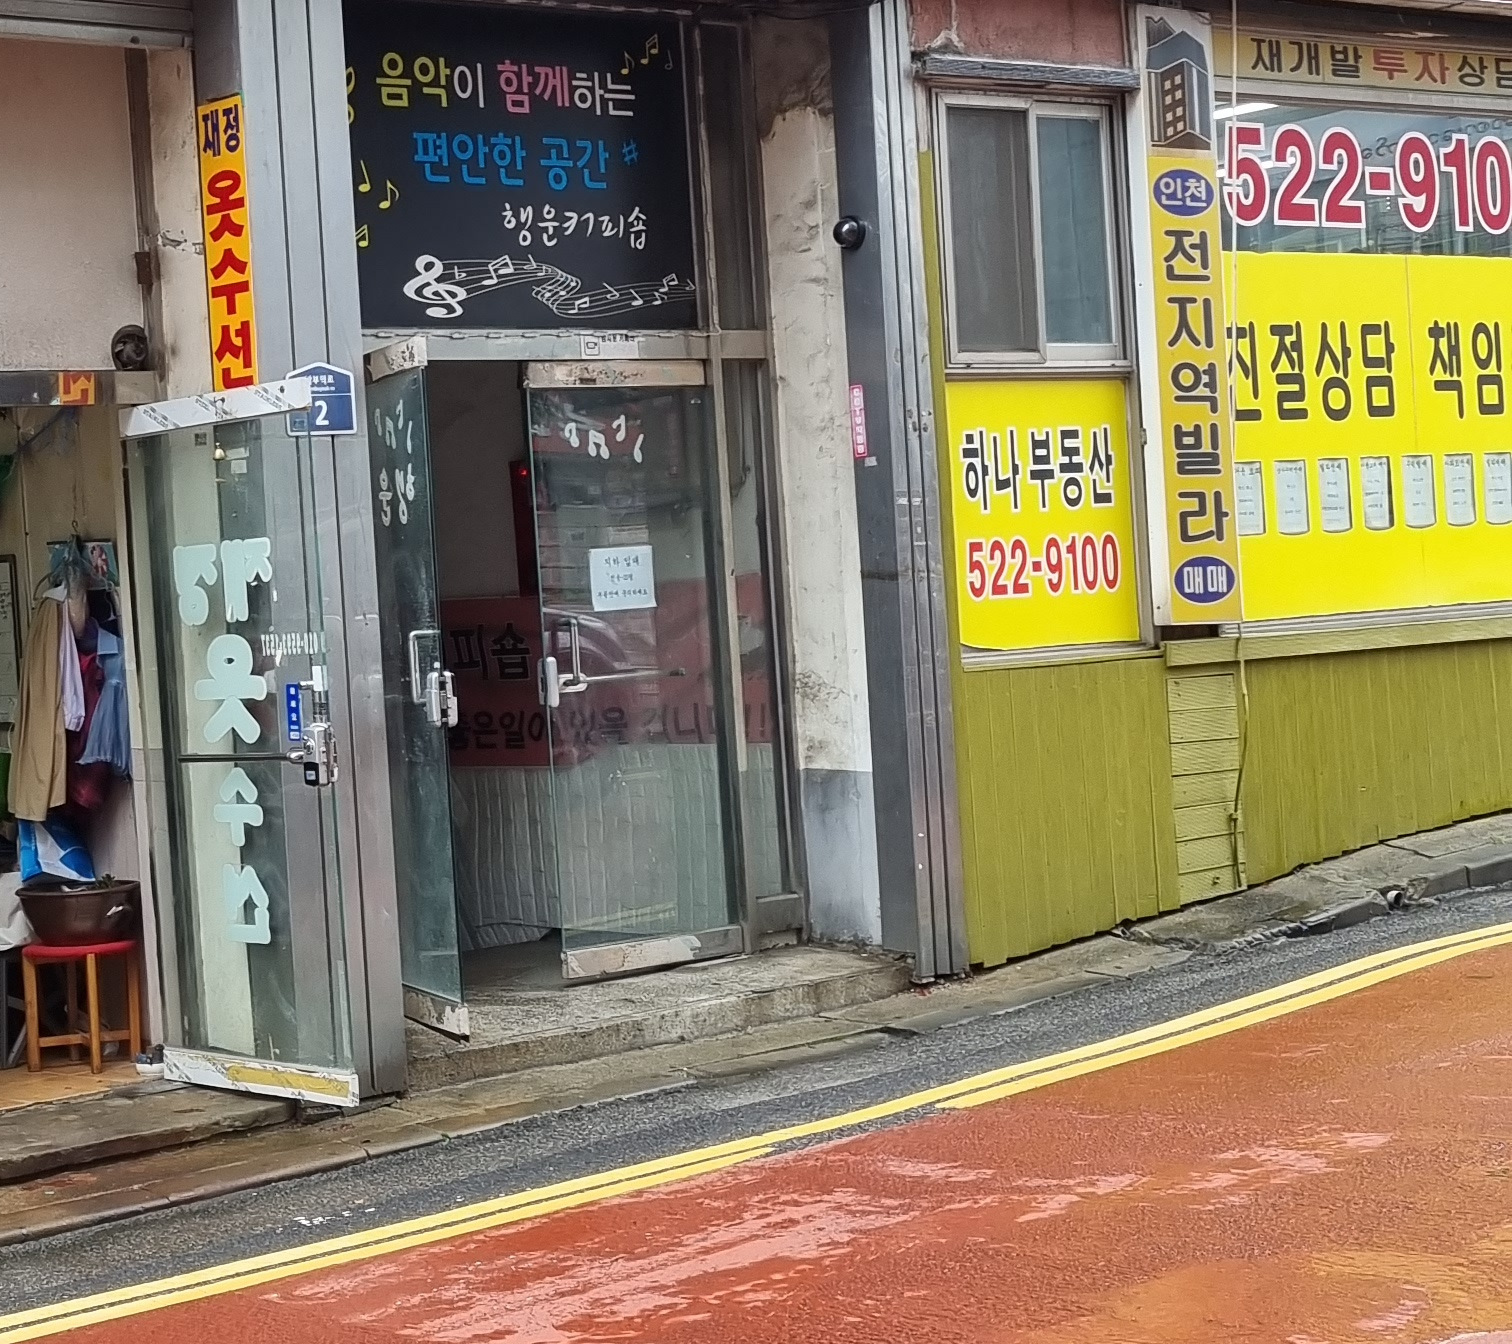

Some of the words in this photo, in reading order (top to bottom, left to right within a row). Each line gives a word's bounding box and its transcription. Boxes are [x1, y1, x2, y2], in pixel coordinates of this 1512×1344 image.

[376, 51, 485, 109] 음악이
[496, 59, 636, 117] 함께하는
[201, 104, 241, 157] 재정
[412, 132, 527, 186] 편안한
[539, 136, 610, 191] 공간
[1159, 177, 1208, 207] 인천
[501, 202, 648, 250] 행운커피숍
[205, 169, 255, 390] 옷수선
[314, 399, 330, 426] 2
[1162, 229, 1230, 543] 전지역빌라
[966, 532, 1120, 600] 522-9100
[1182, 565, 1228, 595] 매매
